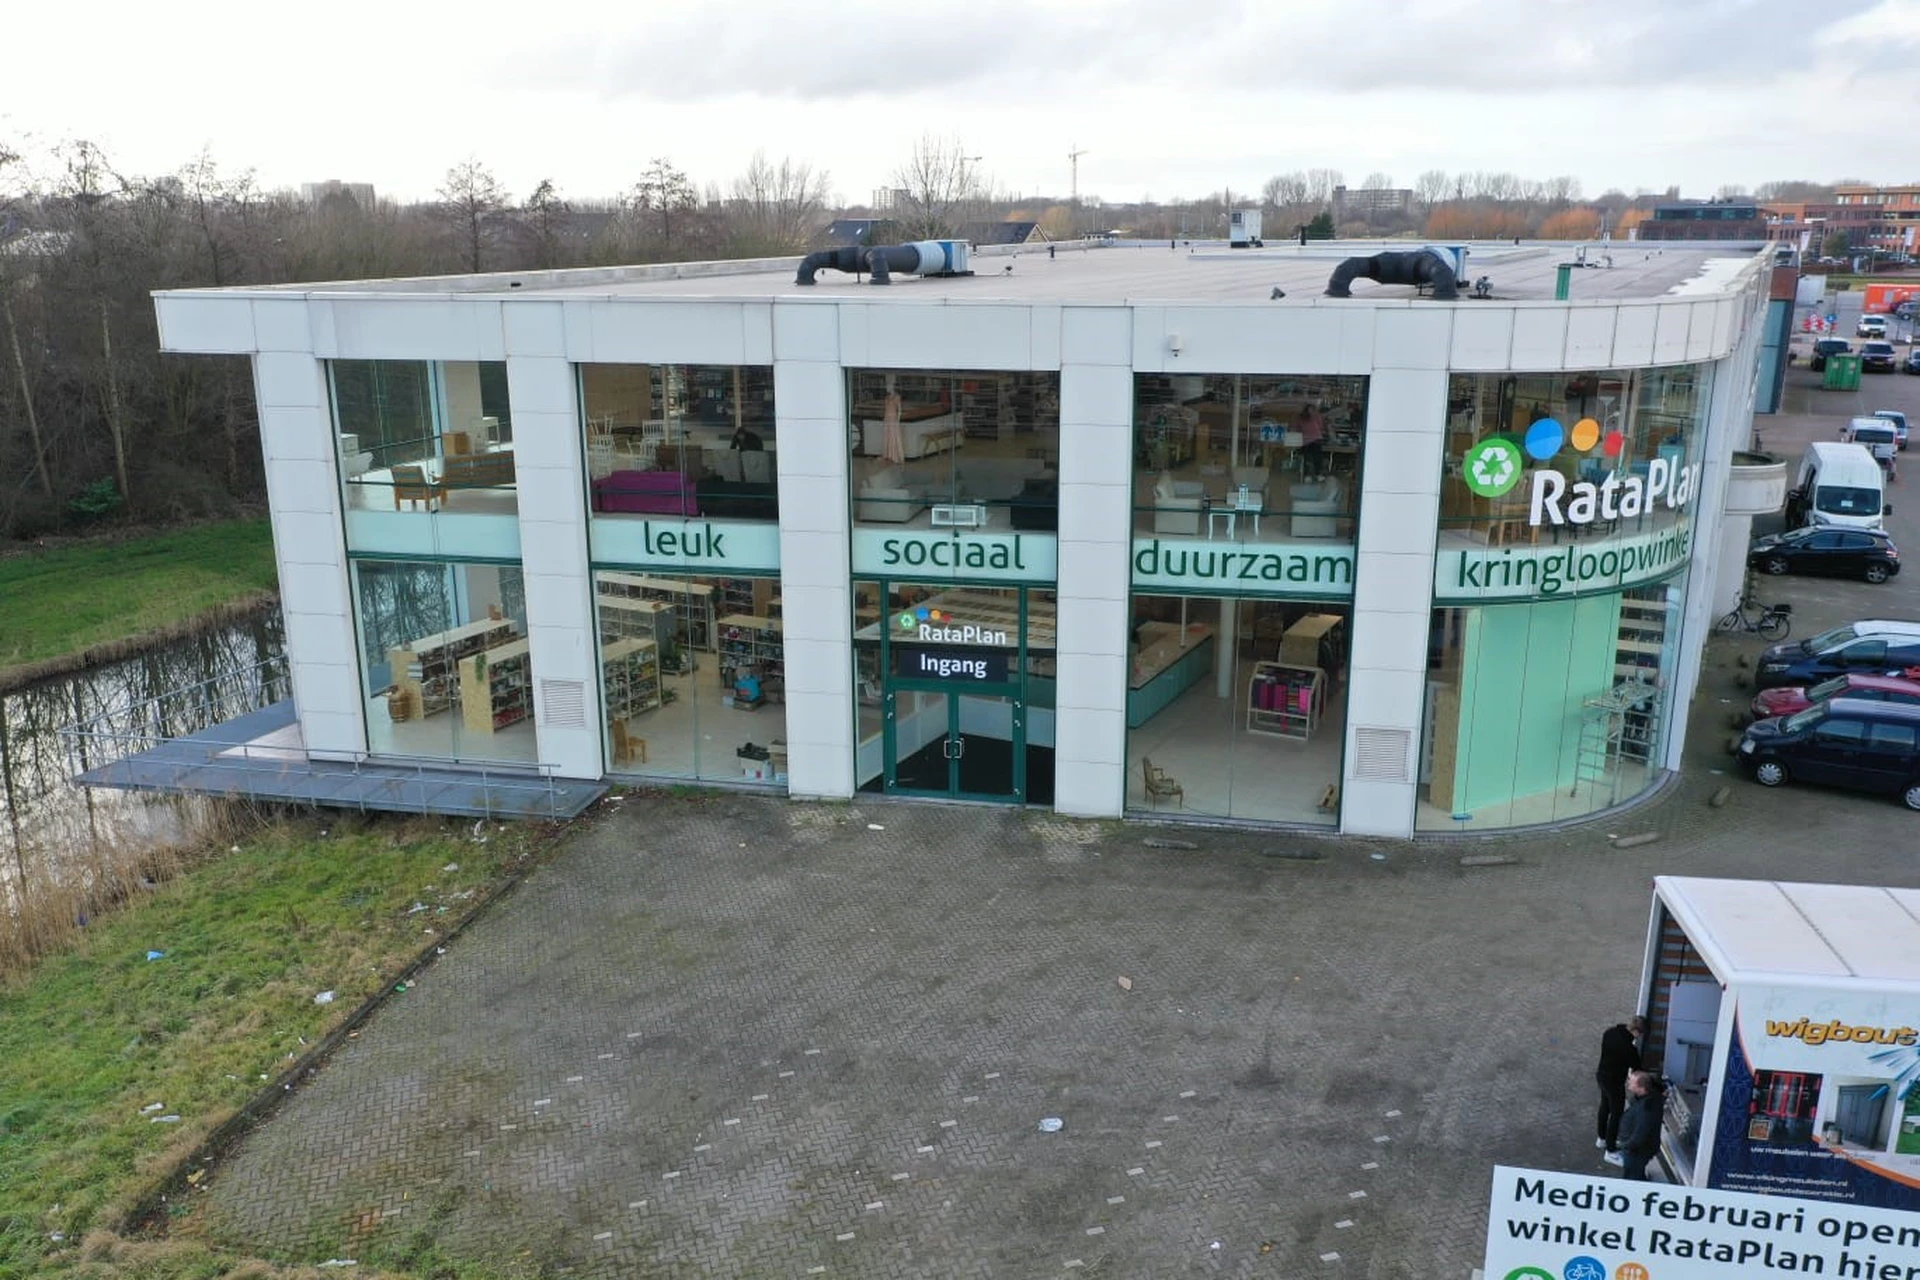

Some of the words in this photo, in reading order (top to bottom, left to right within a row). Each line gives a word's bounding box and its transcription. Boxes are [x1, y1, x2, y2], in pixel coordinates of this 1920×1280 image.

[643, 521, 725, 558] leuk
[883, 531, 1025, 570] sociaal
[1135, 539, 1351, 583] duurzaam
[1459, 526, 1689, 593] kringloopwinke
[919, 624, 1006, 645] RataPlan
[920, 653, 987, 678] Ingang
[1766, 1017, 1919, 1046] wigbout
[1514, 1177, 1631, 1214] Medio
[1642, 1192, 1804, 1233] februari
[1507, 1217, 1635, 1251] winkel
[1649, 1230, 1824, 1274] RataPlan
